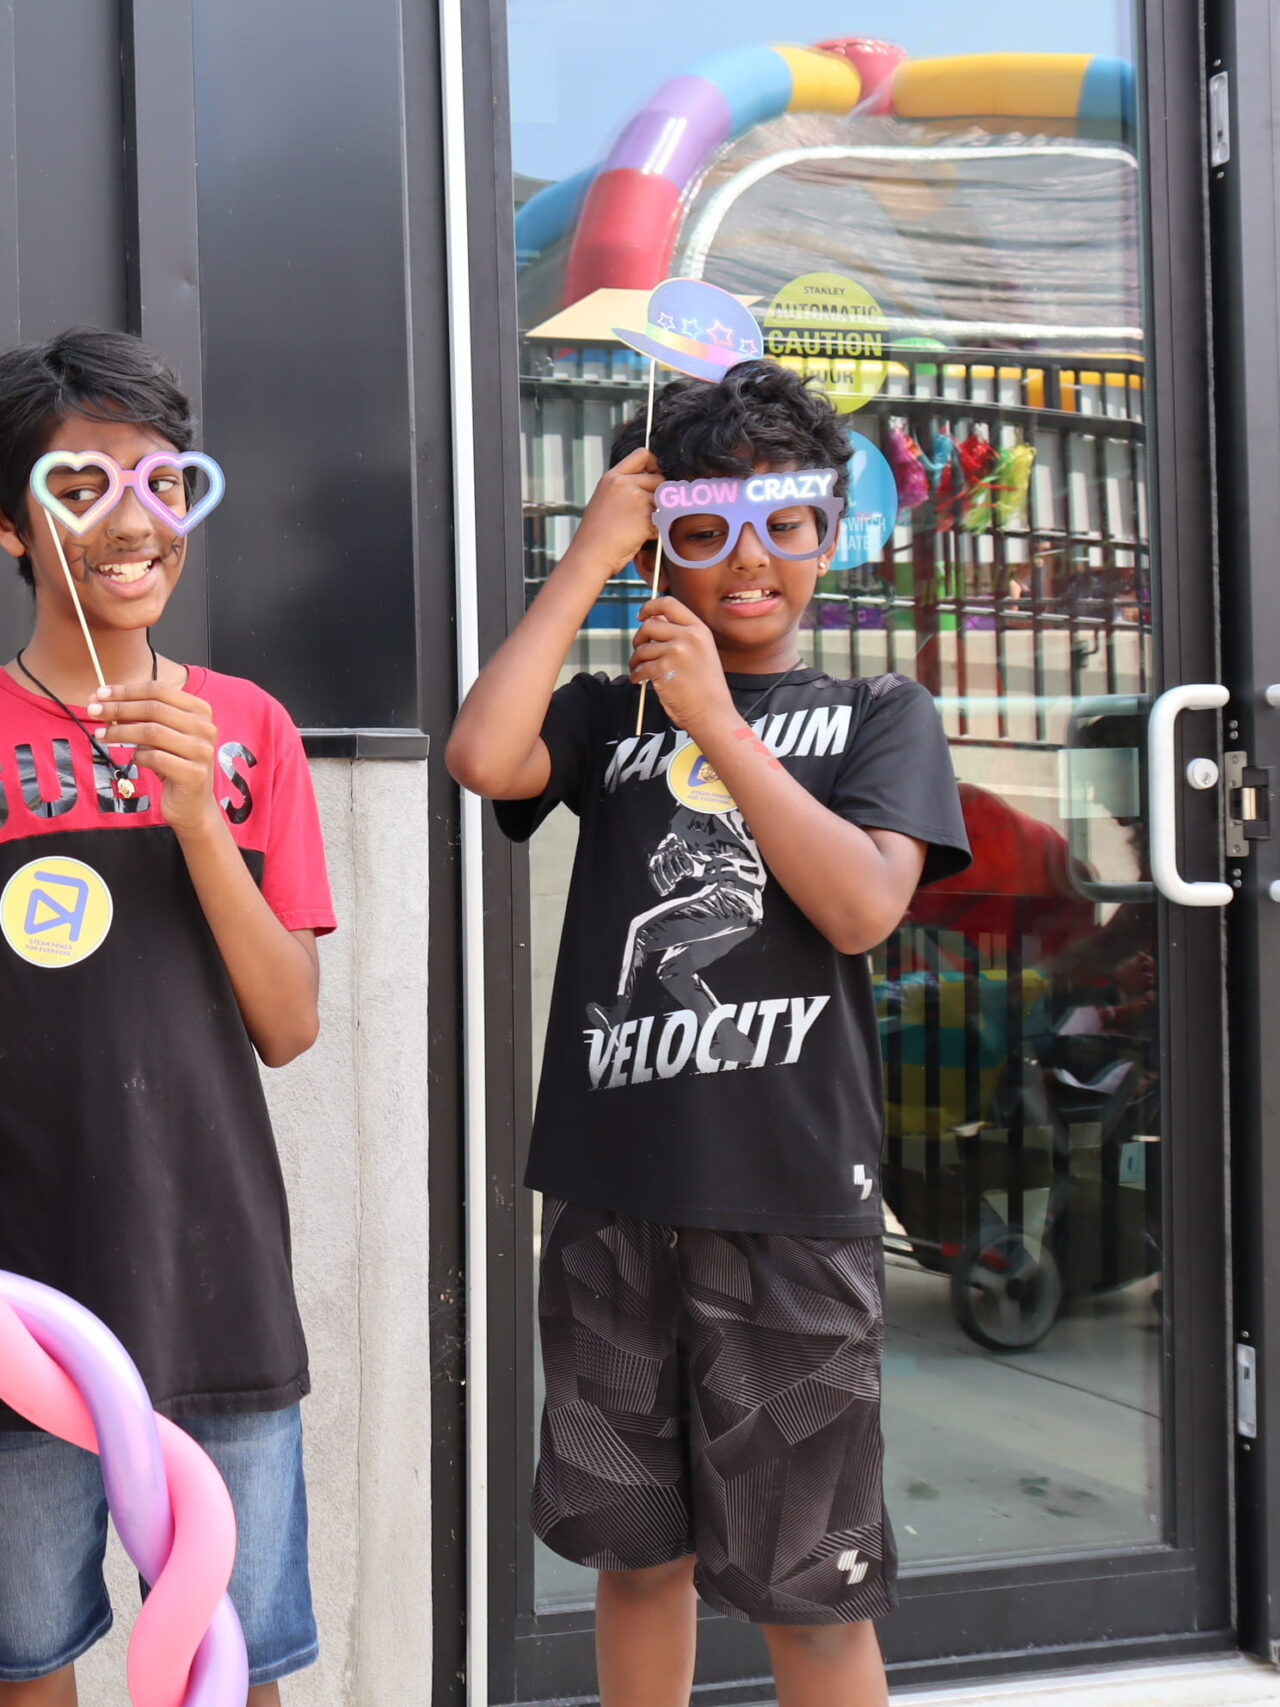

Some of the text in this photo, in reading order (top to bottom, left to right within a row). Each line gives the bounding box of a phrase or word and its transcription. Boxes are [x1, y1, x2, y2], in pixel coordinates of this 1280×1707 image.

[803, 286, 846, 296] STANLEY
[773, 302, 879, 322] AUTOMATIC
[767, 329, 883, 357] CAUTION
[659, 474, 832, 508] GLOW CRAZY
[582, 995, 832, 1092] VELOCITY
